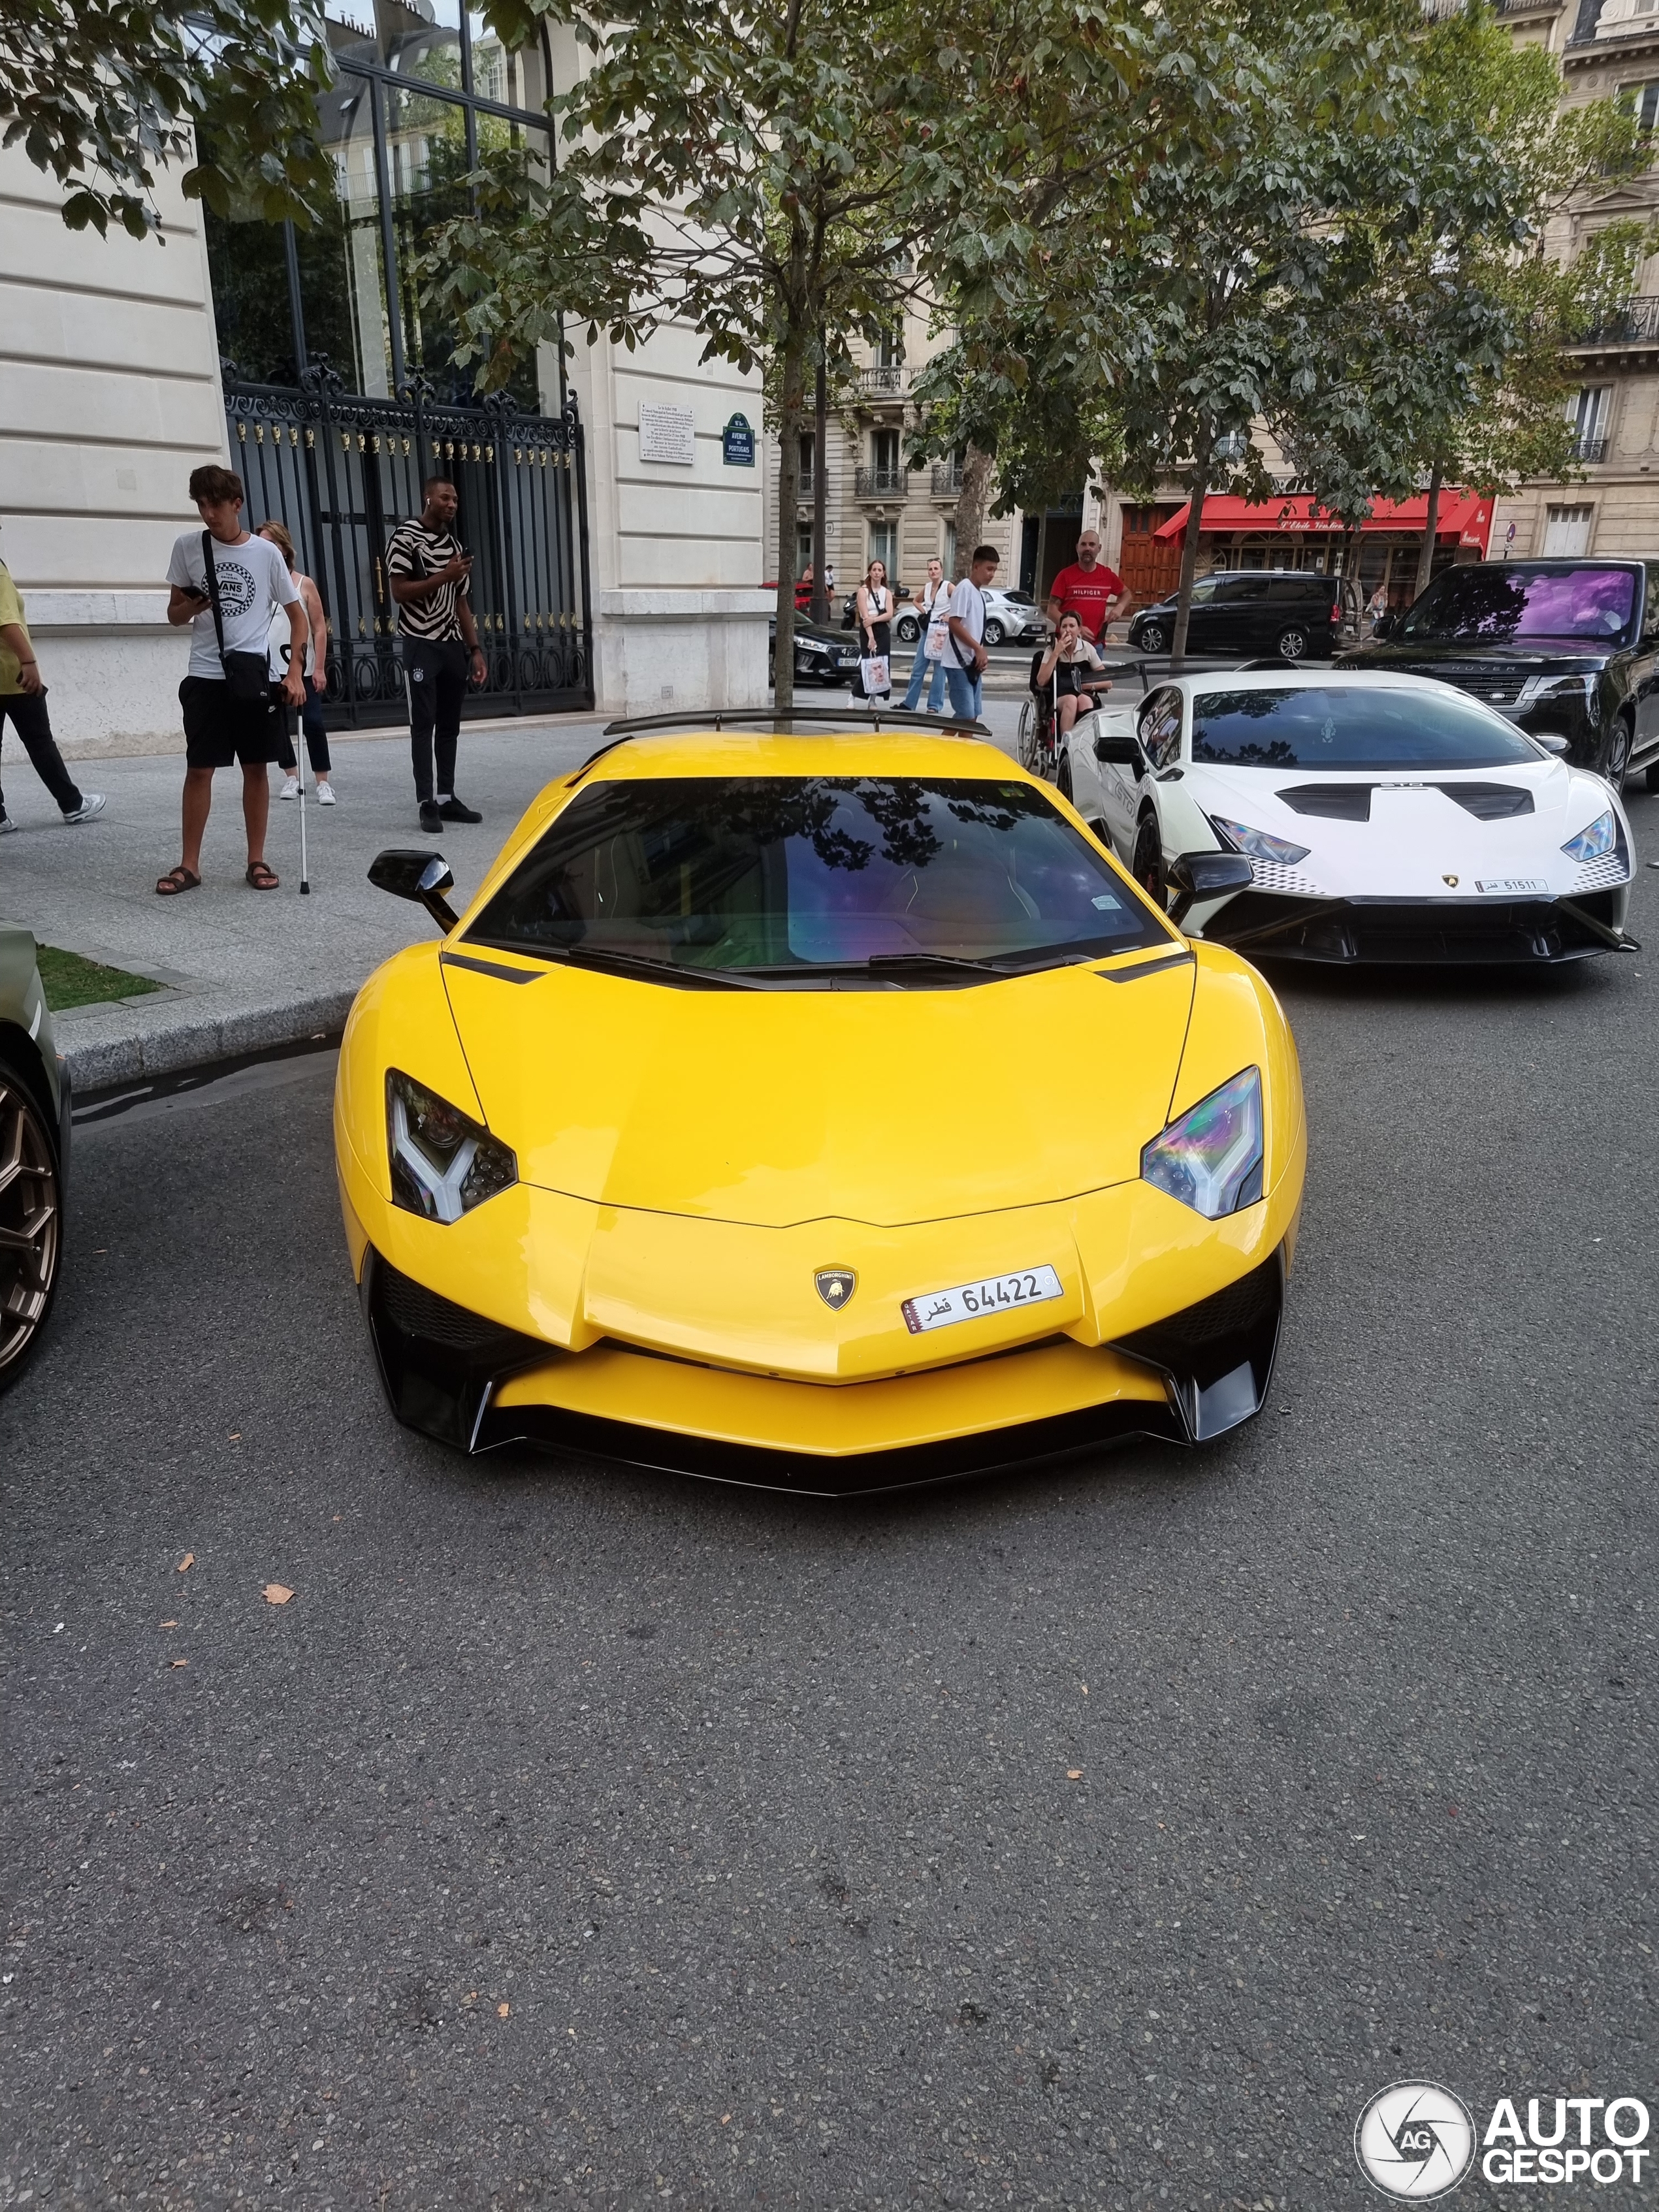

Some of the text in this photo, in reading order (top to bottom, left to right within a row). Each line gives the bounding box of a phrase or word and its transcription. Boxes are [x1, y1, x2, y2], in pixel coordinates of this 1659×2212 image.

[728, 445, 750, 453] PORTUGAIS
[218, 581, 243, 593] VANS
[1504, 880, 1537, 890] 51511
[818, 1272, 852, 1281] LAMBORGHINI
[924, 1274, 1042, 1322] قطر 64422
[903, 1303, 918, 1332] QATAR
